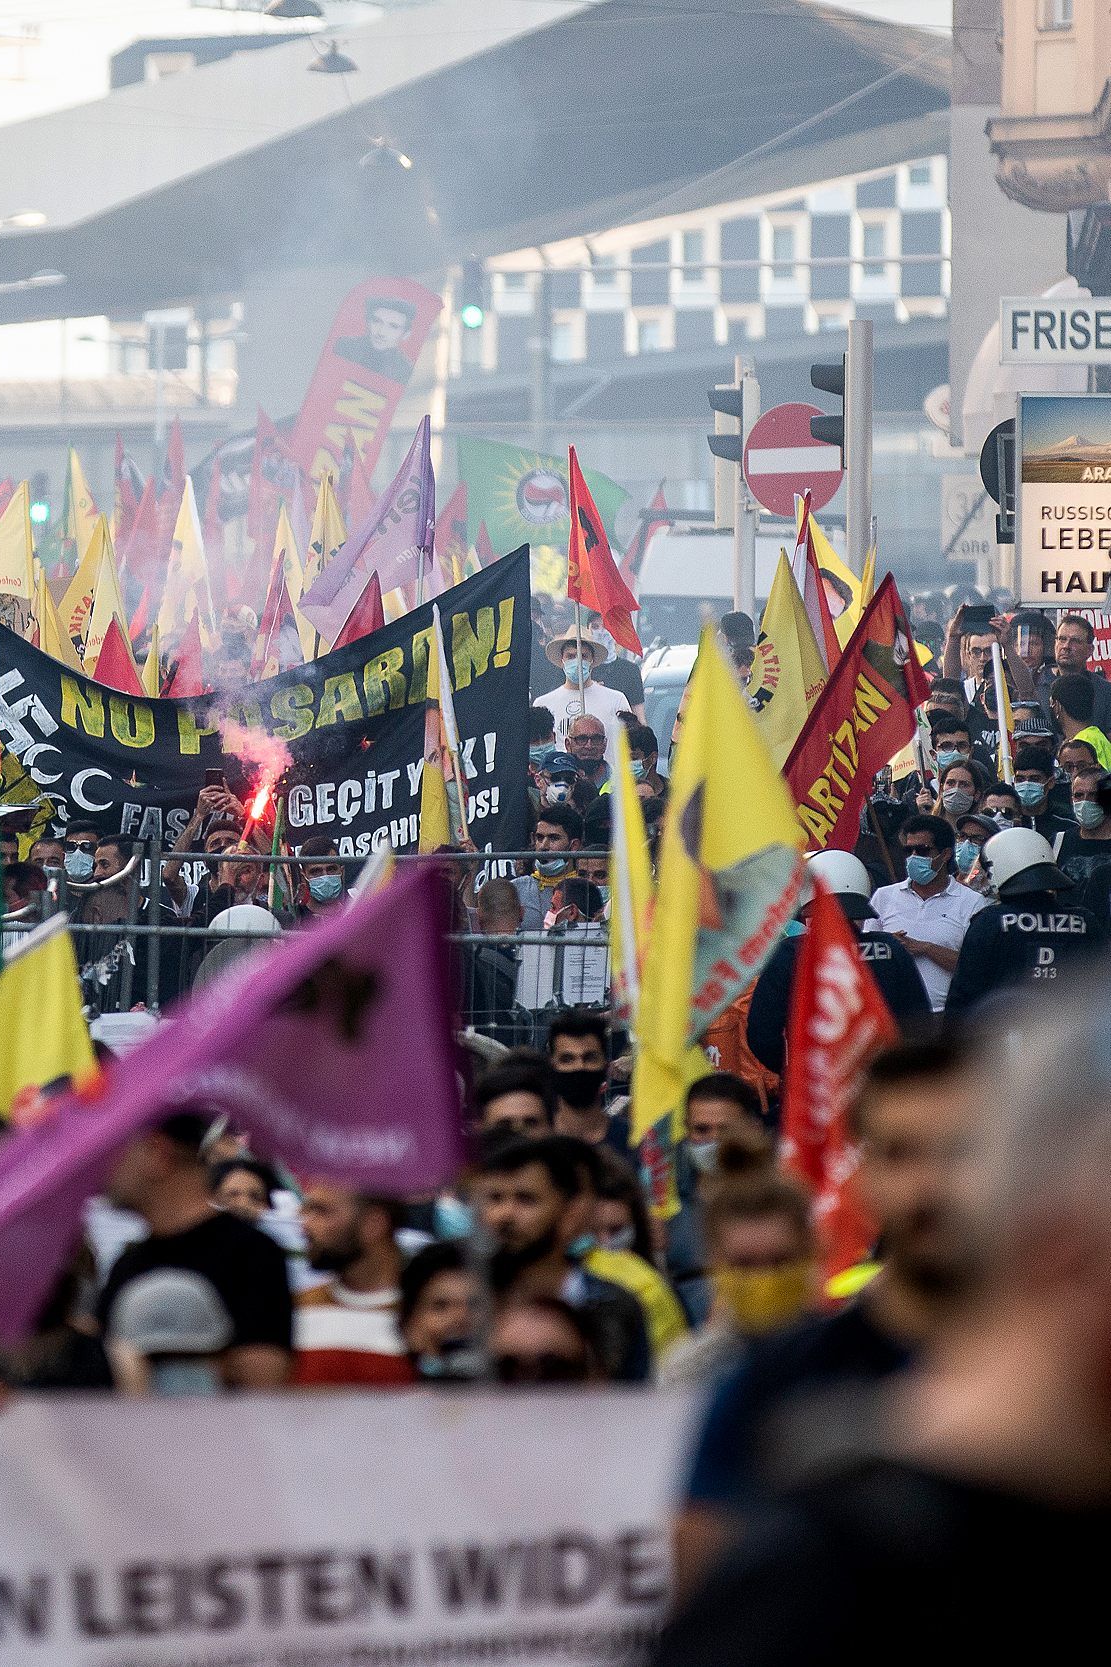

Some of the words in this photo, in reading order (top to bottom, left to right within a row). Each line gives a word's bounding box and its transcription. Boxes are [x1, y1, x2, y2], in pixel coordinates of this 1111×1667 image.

[1011, 309, 1111, 350] FRISE
[1041, 506, 1111, 520] RUSSIS
[1041, 527, 1111, 550] LEBE
[60, 674, 156, 749] NO
[1002, 912, 1087, 934] POLIZEI
[1038, 947, 1055, 965] D
[1033, 966, 1058, 979] 313
[68, 1549, 414, 1640] LEISTEN
[430, 1527, 670, 1616] WIDE
